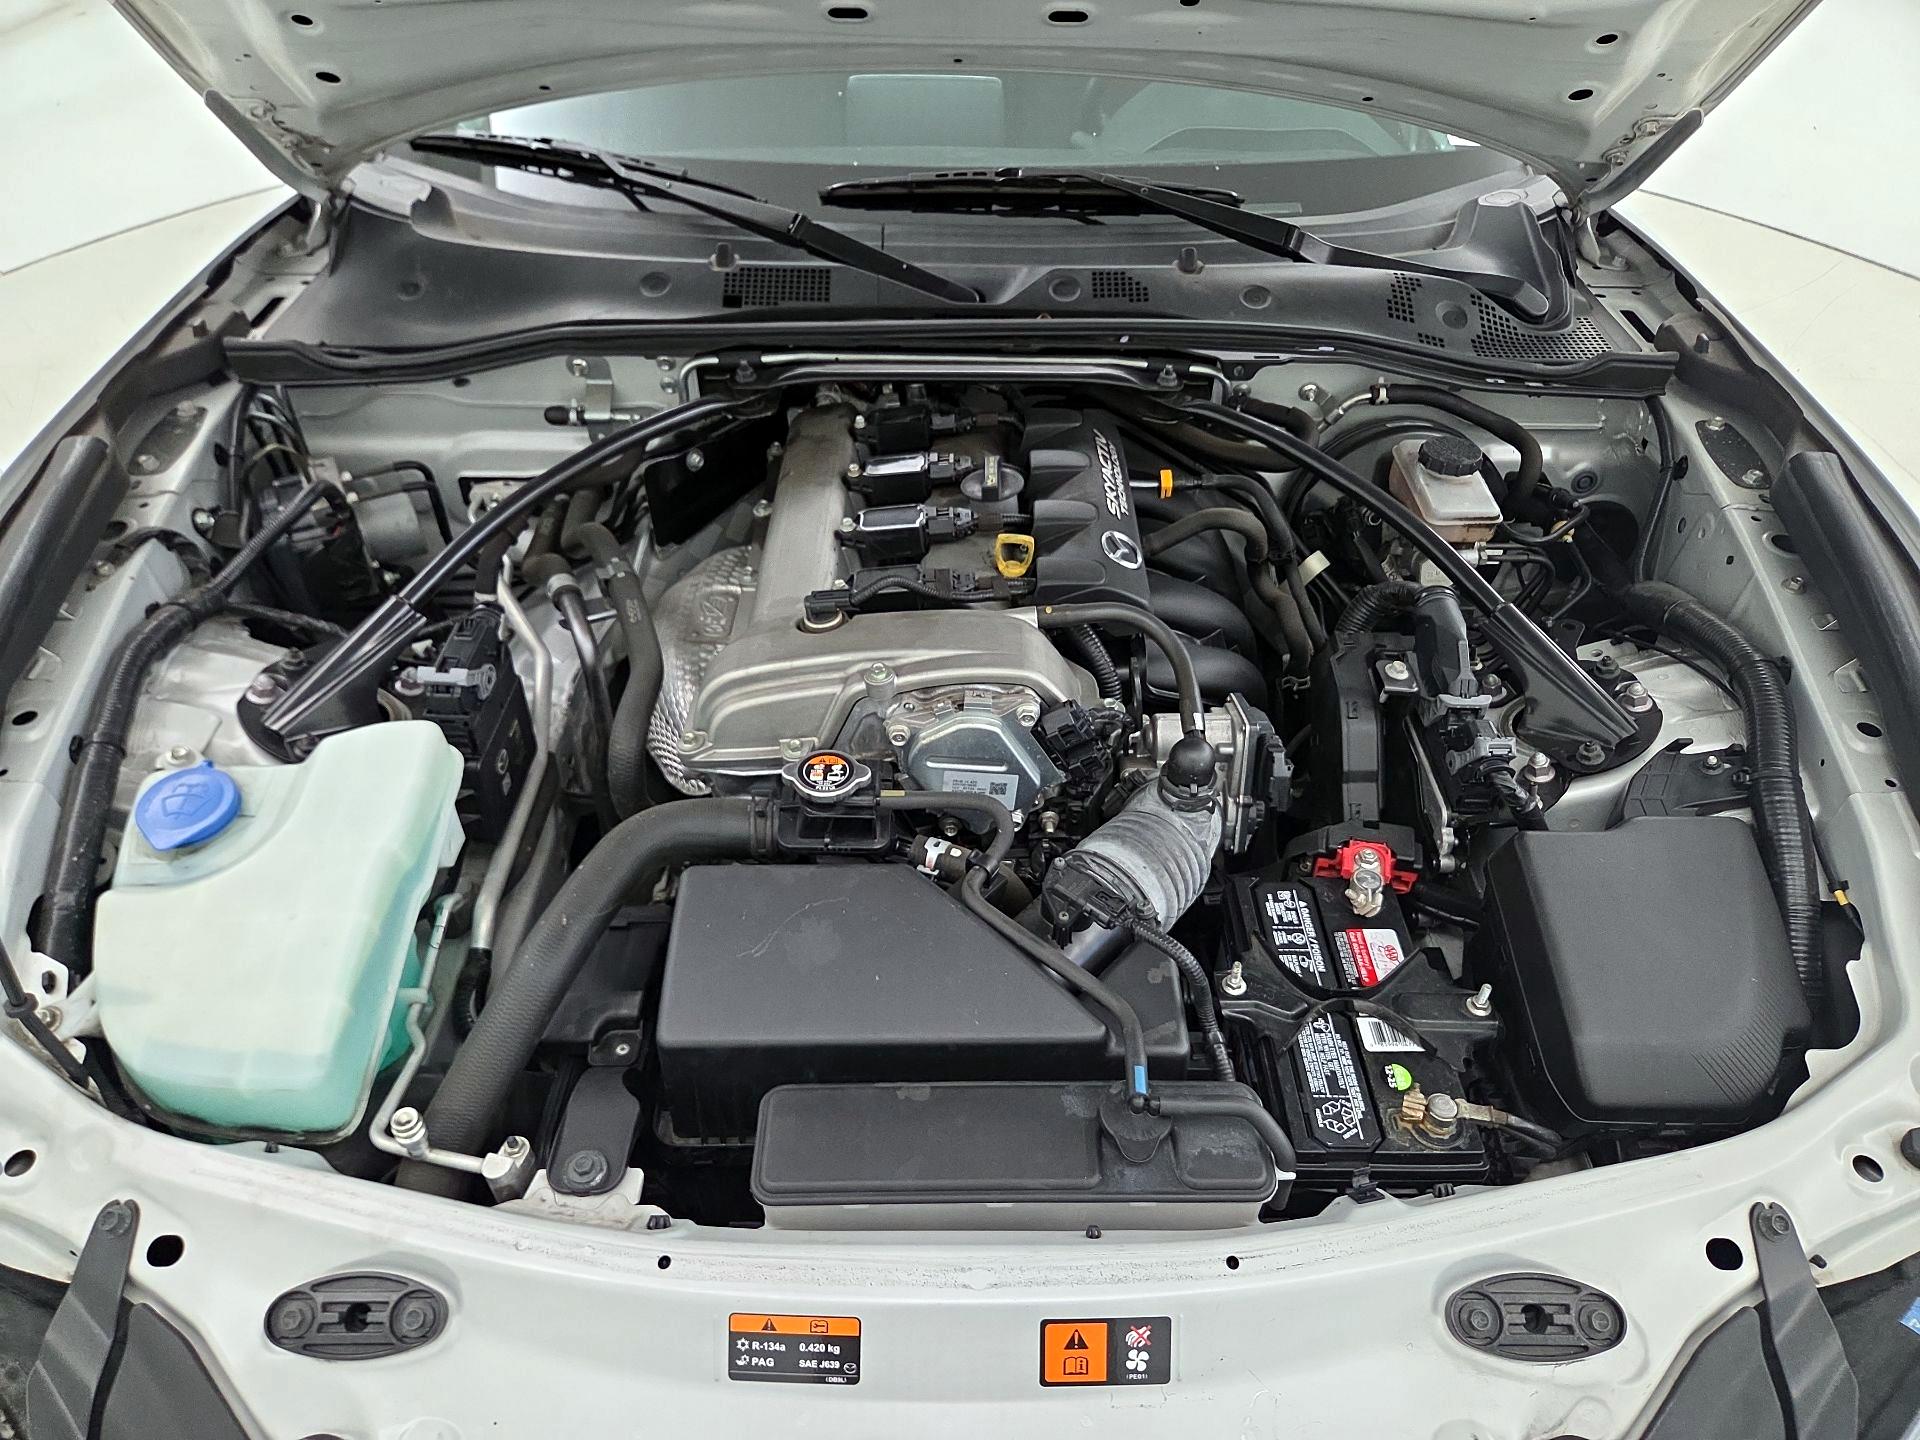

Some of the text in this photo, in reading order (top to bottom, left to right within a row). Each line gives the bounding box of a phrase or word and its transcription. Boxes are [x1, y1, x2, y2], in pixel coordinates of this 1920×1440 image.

[1093, 428, 1121, 519] SKYACTIV
[1108, 440, 1129, 515] TECHNOLOGY
[1300, 907, 1316, 936] DANGER
[1310, 943, 1326, 972] POISON
[751, 1341, 841, 1355] R-134a 0.420 kg
[751, 1358, 840, 1369] PAG SAE J639
